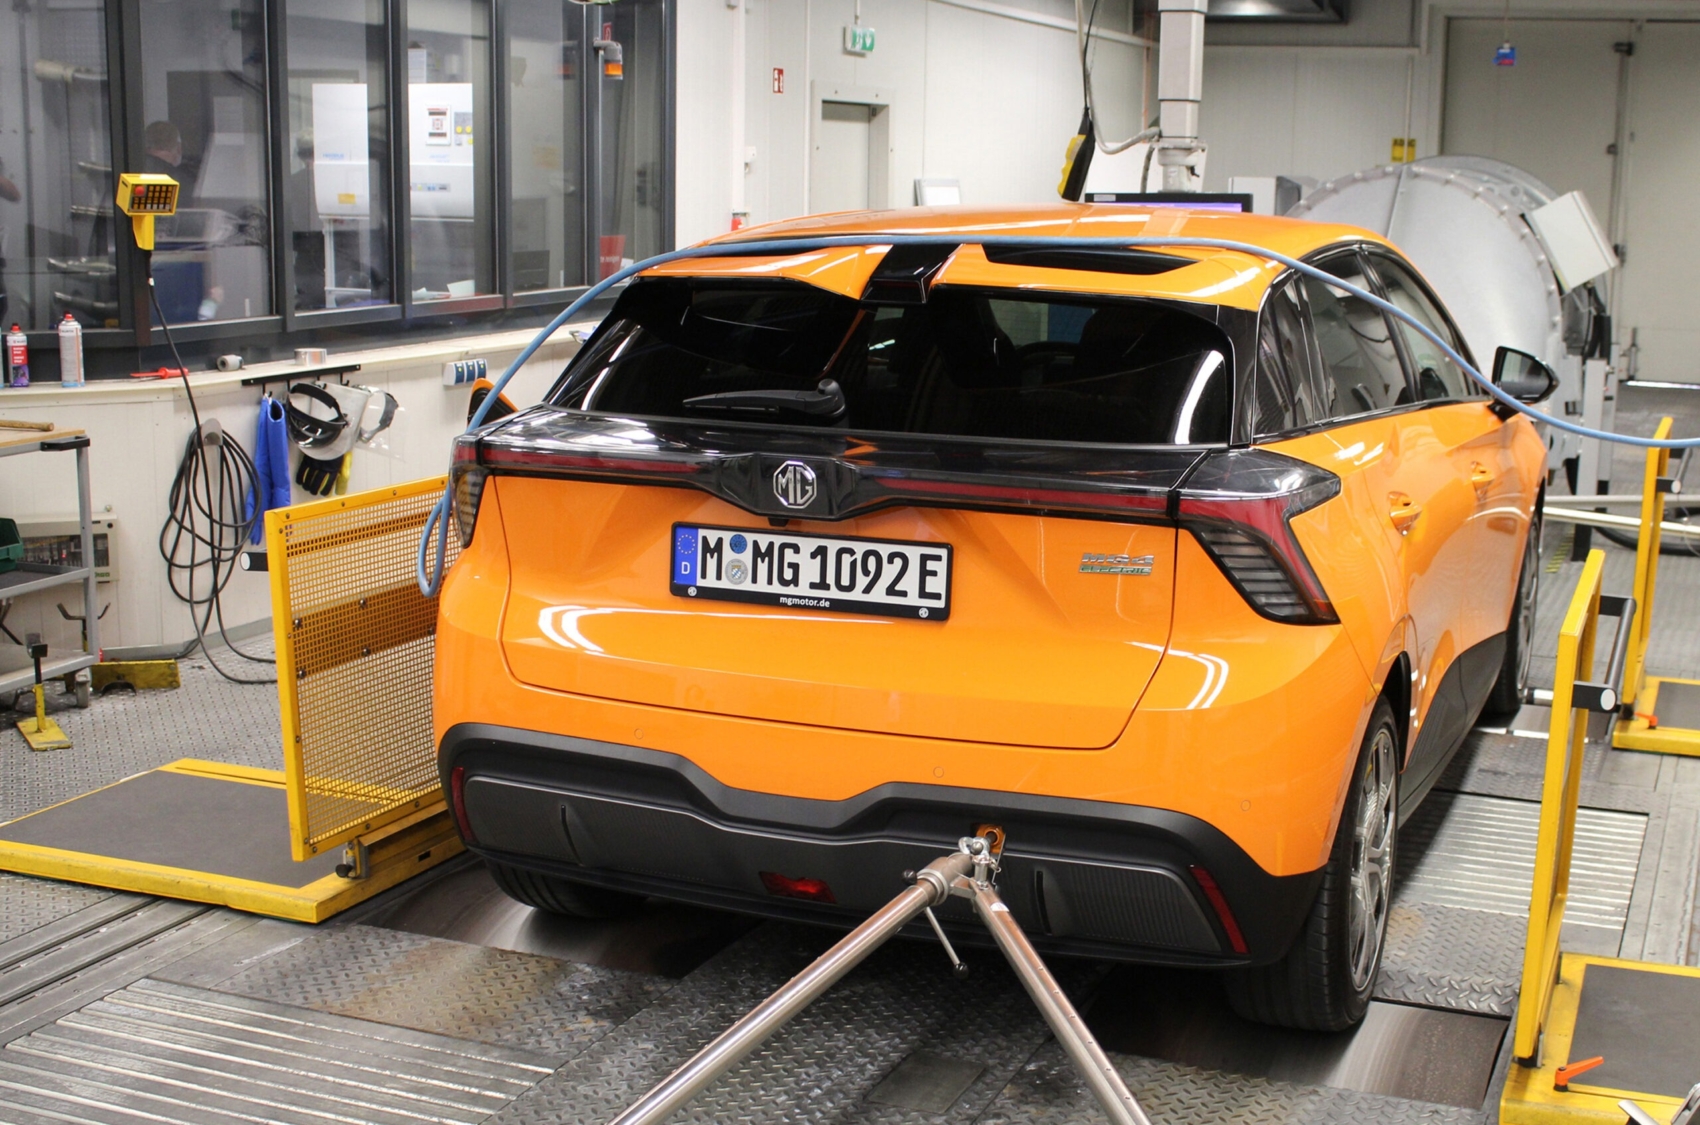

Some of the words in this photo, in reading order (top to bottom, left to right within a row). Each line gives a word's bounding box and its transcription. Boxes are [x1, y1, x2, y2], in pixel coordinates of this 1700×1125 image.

[776, 464, 814, 506] MG
[680, 561, 691, 575] D
[700, 535, 724, 581] M
[779, 596, 831, 608] mgmotor.de
